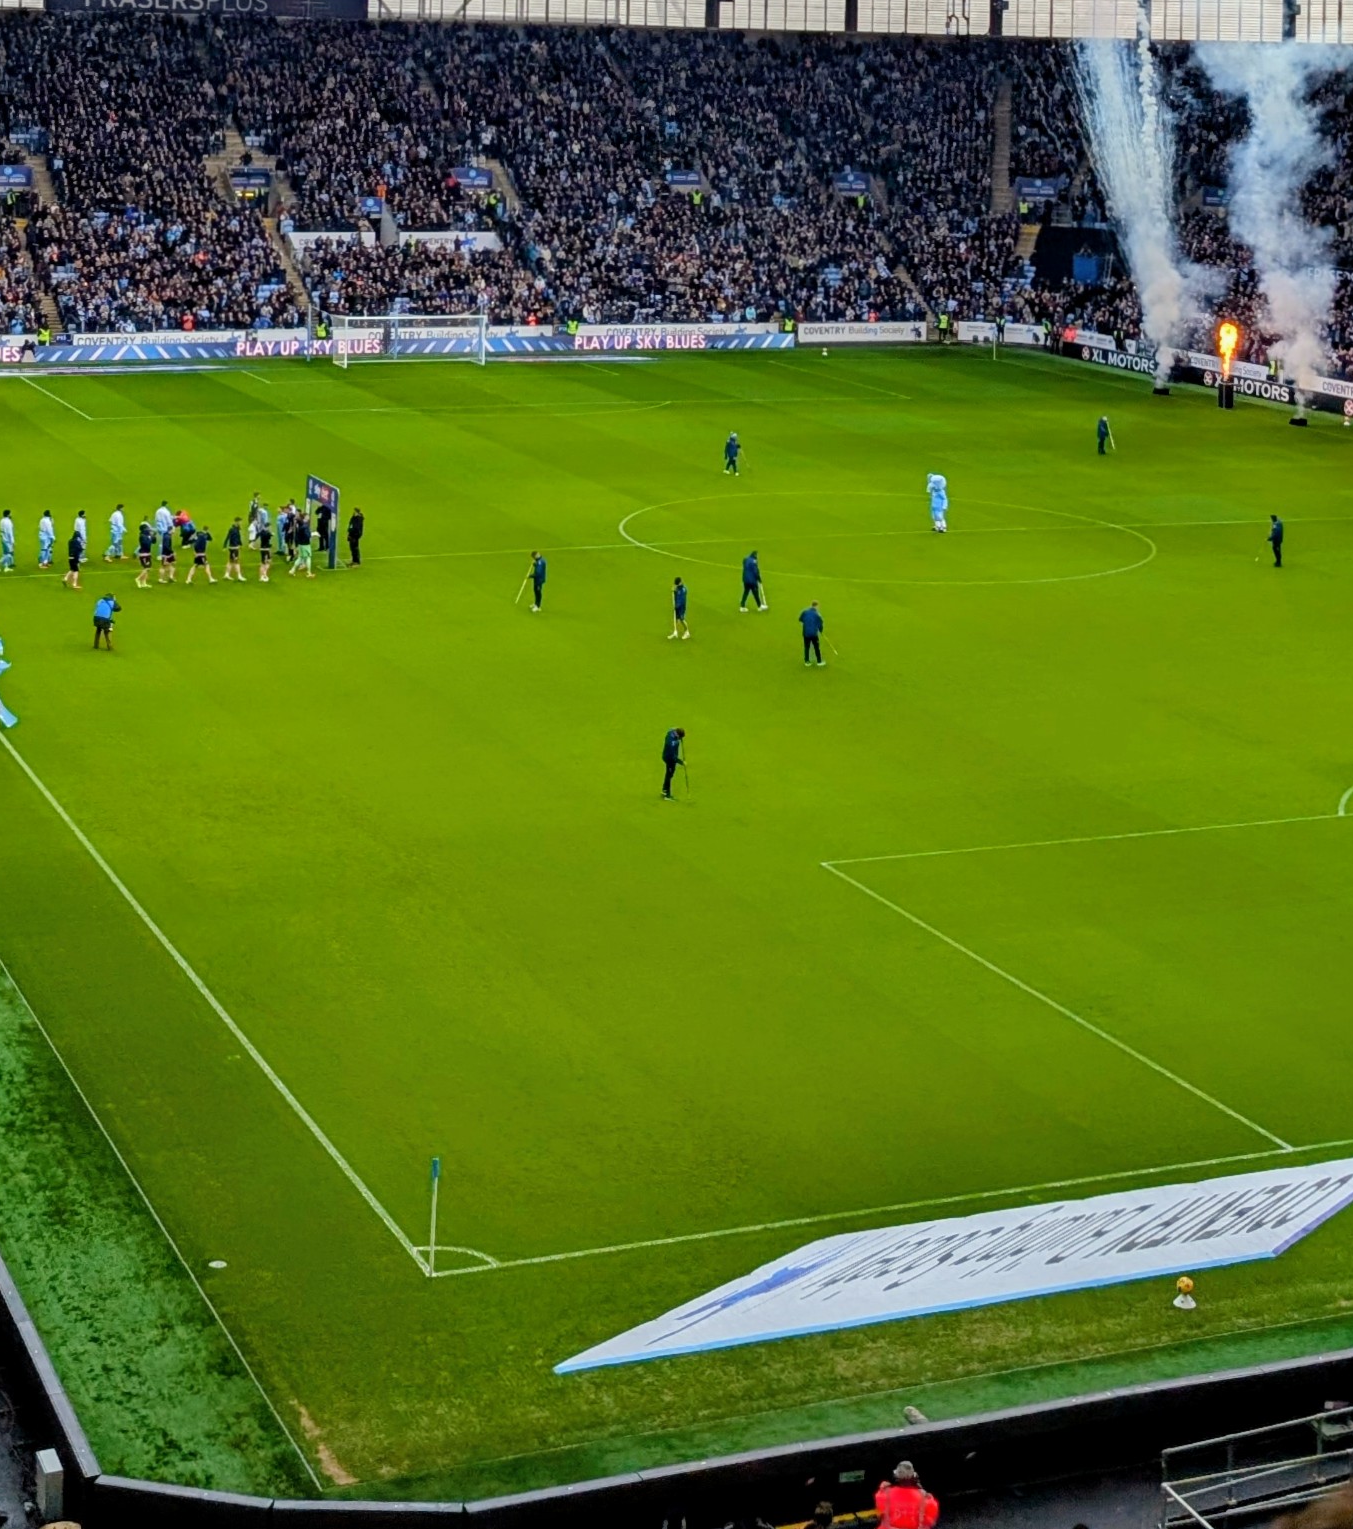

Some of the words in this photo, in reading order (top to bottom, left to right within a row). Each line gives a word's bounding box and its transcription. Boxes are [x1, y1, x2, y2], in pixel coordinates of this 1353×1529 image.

[803, 325, 845, 335] COVENTRY
[848, 325, 878, 336] Building
[879, 325, 905, 335] Society
[236, 341, 275, 357] PLAY
[280, 340, 299, 355] UP
[304, 340, 333, 355] SKY
[338, 339, 381, 354] BLUES
[575, 336, 609, 350] PLAY
[614, 335, 631, 349] UP
[636, 335, 663, 349] SKY
[666, 334, 706, 349] BLUES
[1092, 348, 1106, 364] XL
[1233, 377, 1290, 403] MOTORS
[1081, 1173, 1353, 1260] COVENTRY
[949, 1203, 1155, 1280] Building
